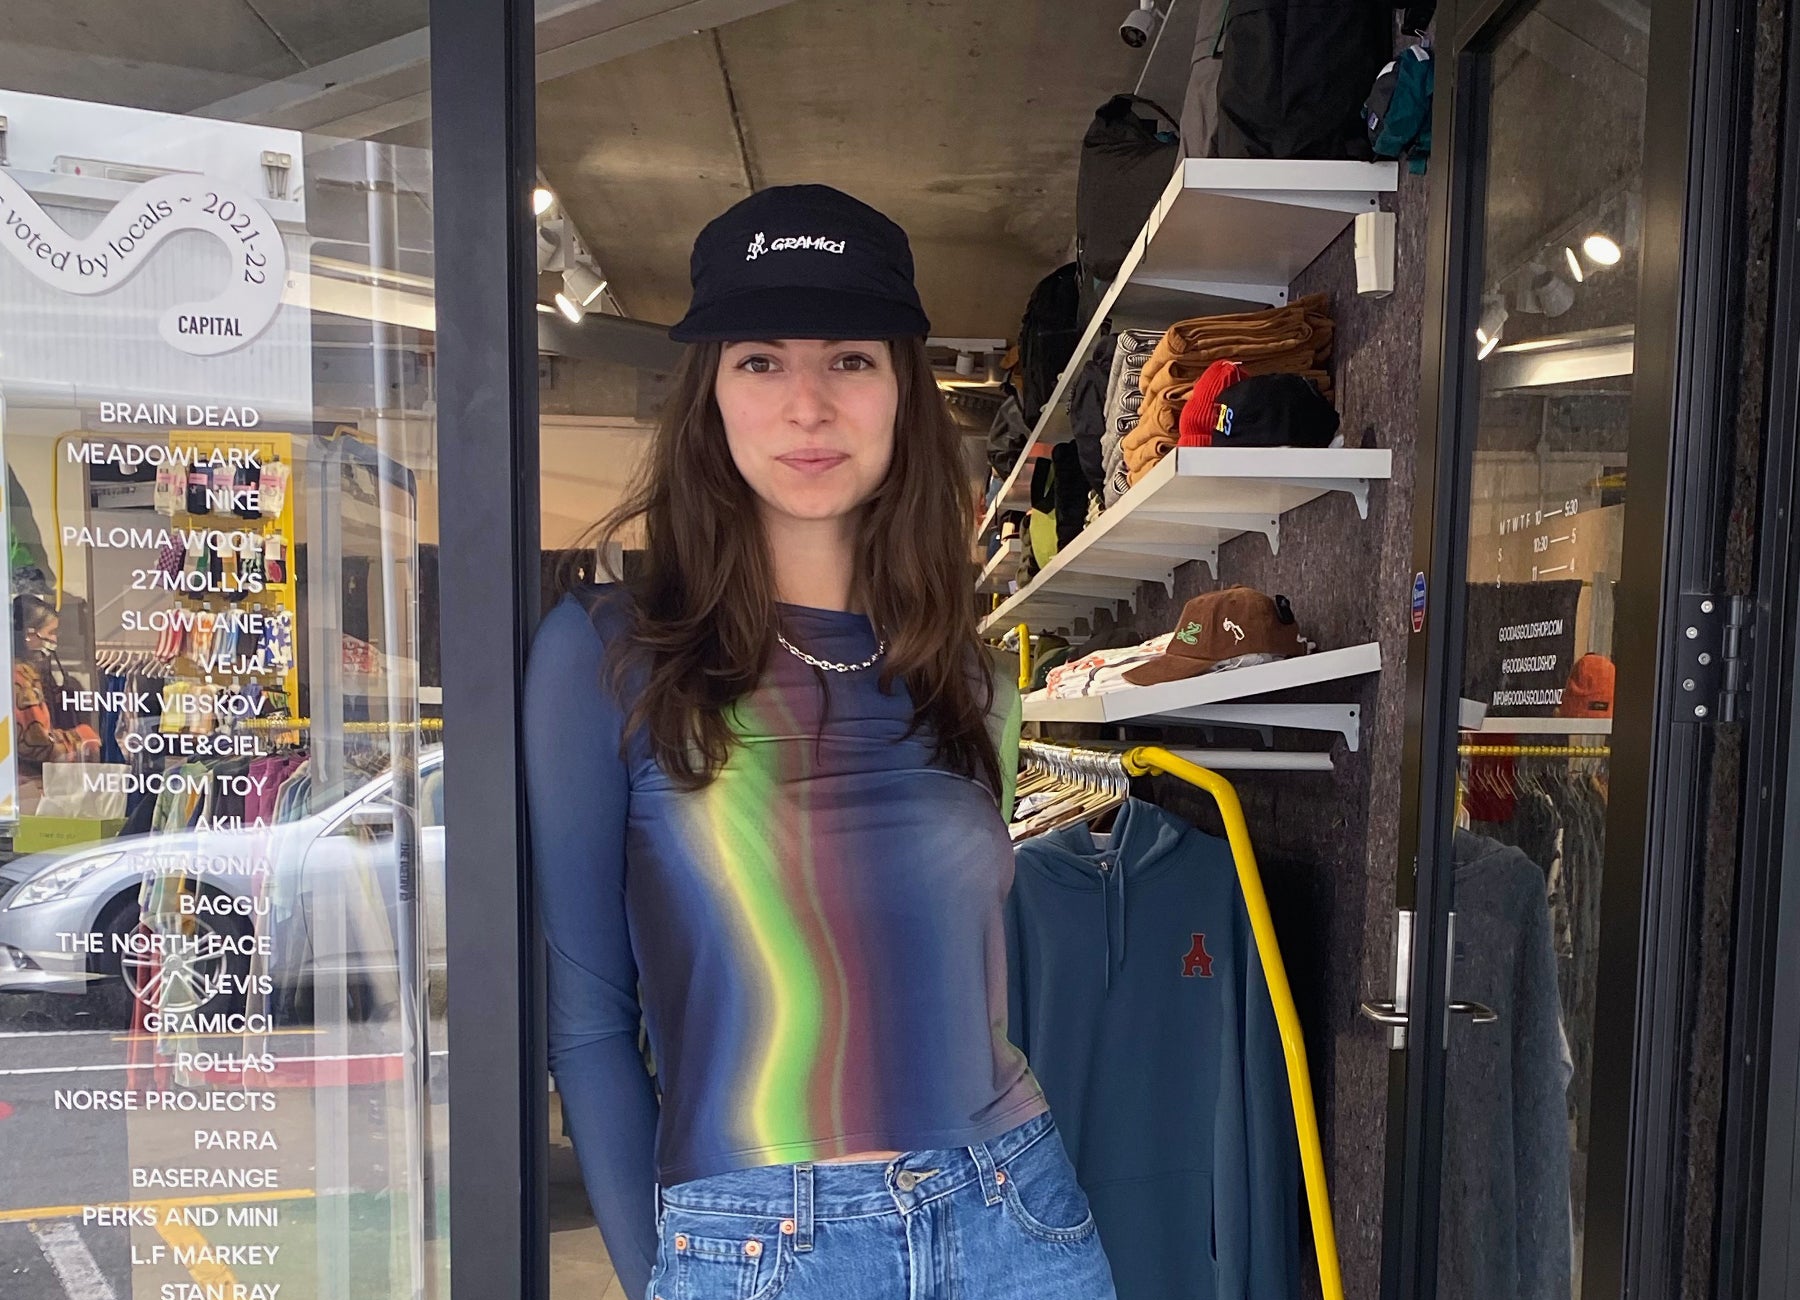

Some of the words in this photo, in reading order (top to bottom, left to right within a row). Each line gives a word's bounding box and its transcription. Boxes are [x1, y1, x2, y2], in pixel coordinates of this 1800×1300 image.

[6, 210, 71, 271] voted
[77, 254, 109, 278] by
[109, 200, 174, 260] locals
[202, 192, 267, 285] 2021-22
[178, 316, 243, 336] CAPITAL
[100, 402, 177, 425] BRAIN
[187, 405, 259, 427] DEAD
[67, 443, 261, 469] MEADOWLARK
[205, 489, 261, 511] NIKE
[62, 526, 172, 549] PALOMA
[180, 530, 263, 553] WOOL
[131, 569, 263, 593] 27MOLLYS
[121, 611, 264, 635] SLOWLANE
[200, 654, 266, 675] VEJA
[62, 691, 151, 713] HENRIK
[157, 693, 266, 716] VIBSKOV
[124, 733, 268, 756] COTE&CIEL
[83, 773, 209, 795] MEDICOM
[217, 775, 268, 796] TOY
[194, 815, 270, 835] AKILA
[179, 894, 271, 916] BAGGU
[56, 932, 104, 953] THE
[112, 933, 199, 954] NORTH
[208, 935, 272, 956] FACE
[1181, 933, 1215, 978] A
[204, 974, 273, 995] LEVIS
[143, 1012, 273, 1034] GRAMICCI
[178, 1052, 275, 1073] ROLLAS
[54, 1090, 137, 1111] NORSE
[146, 1090, 277, 1112] PROJECTS
[194, 1130, 278, 1151] PARRA
[132, 1168, 278, 1189] BASERANGE
[82, 1207, 157, 1227] PERKS
[164, 1207, 219, 1227] AND
[226, 1207, 278, 1227] MINI
[131, 1245, 166, 1265] L.F
[173, 1245, 280, 1265] MARKEY
